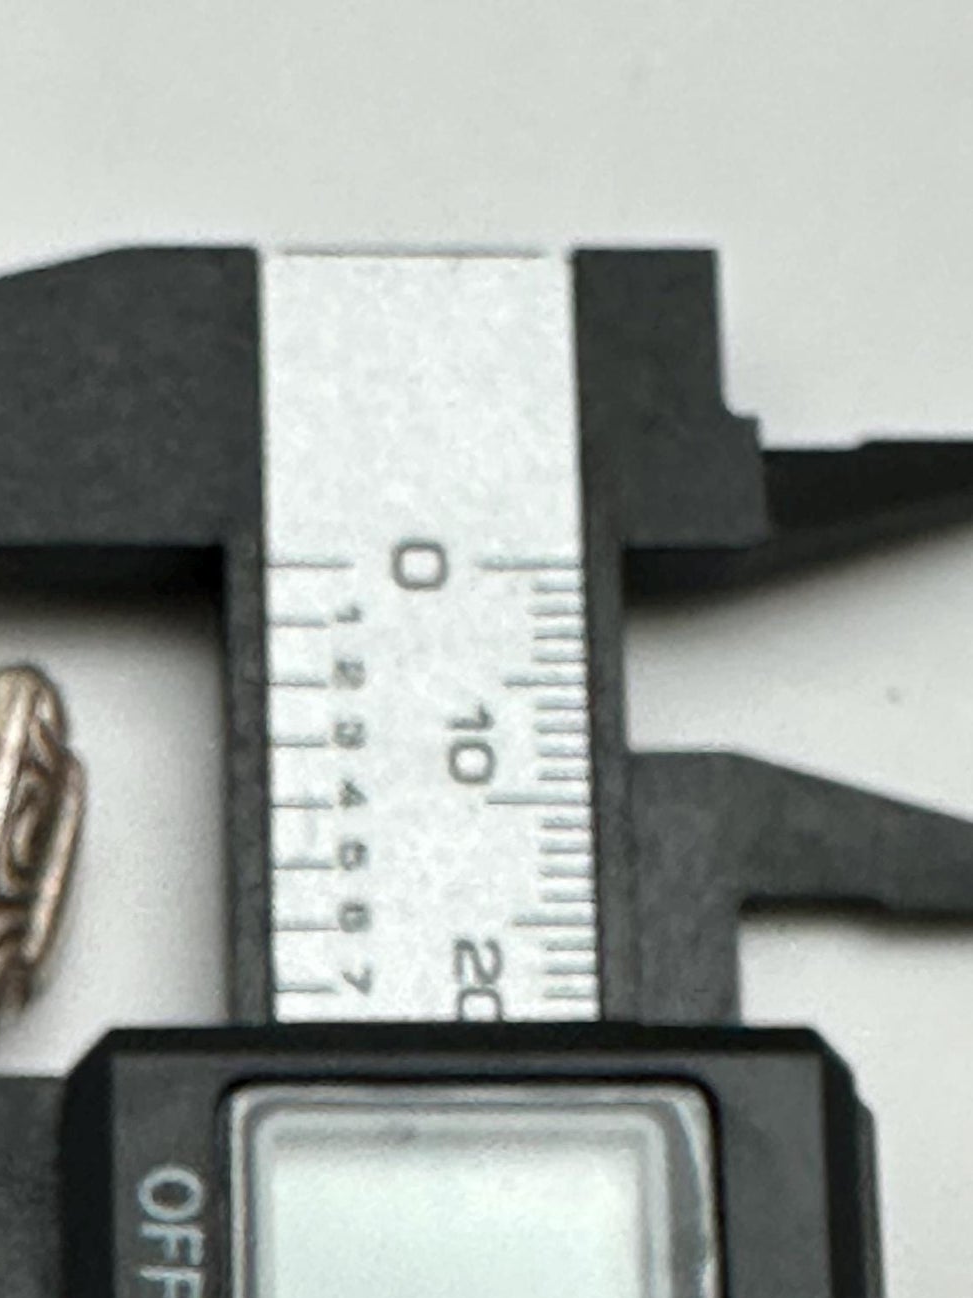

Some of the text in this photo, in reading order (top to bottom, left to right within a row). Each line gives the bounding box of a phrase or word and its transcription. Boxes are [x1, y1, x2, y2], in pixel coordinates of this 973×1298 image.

[392, 542, 448, 591] 0
[448, 705, 497, 786] 10
[334, 605, 371, 995] 1 2 3 4 5 6 7
